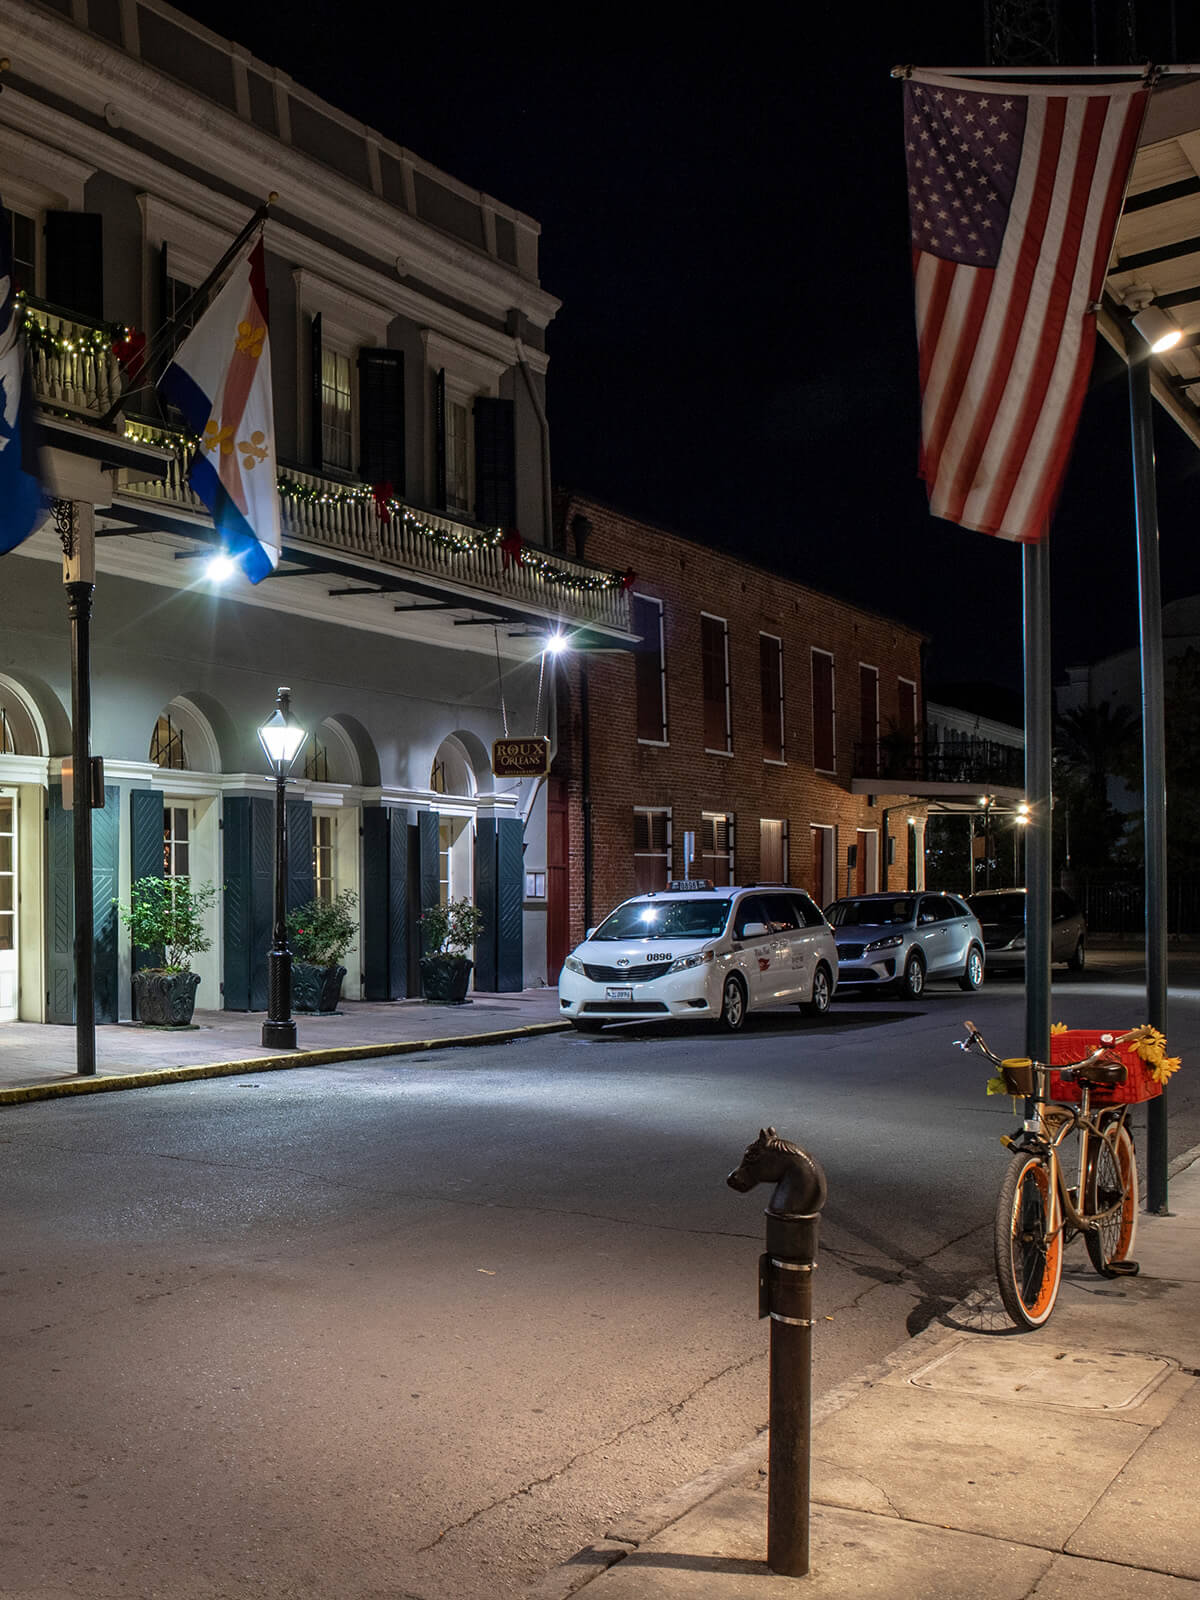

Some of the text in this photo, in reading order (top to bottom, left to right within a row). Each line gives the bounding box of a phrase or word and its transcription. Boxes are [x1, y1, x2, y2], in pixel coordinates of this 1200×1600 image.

[496, 743, 544, 756] ROUX
[500, 755, 540, 769] ORLEANS
[646, 952, 673, 962] 0896
